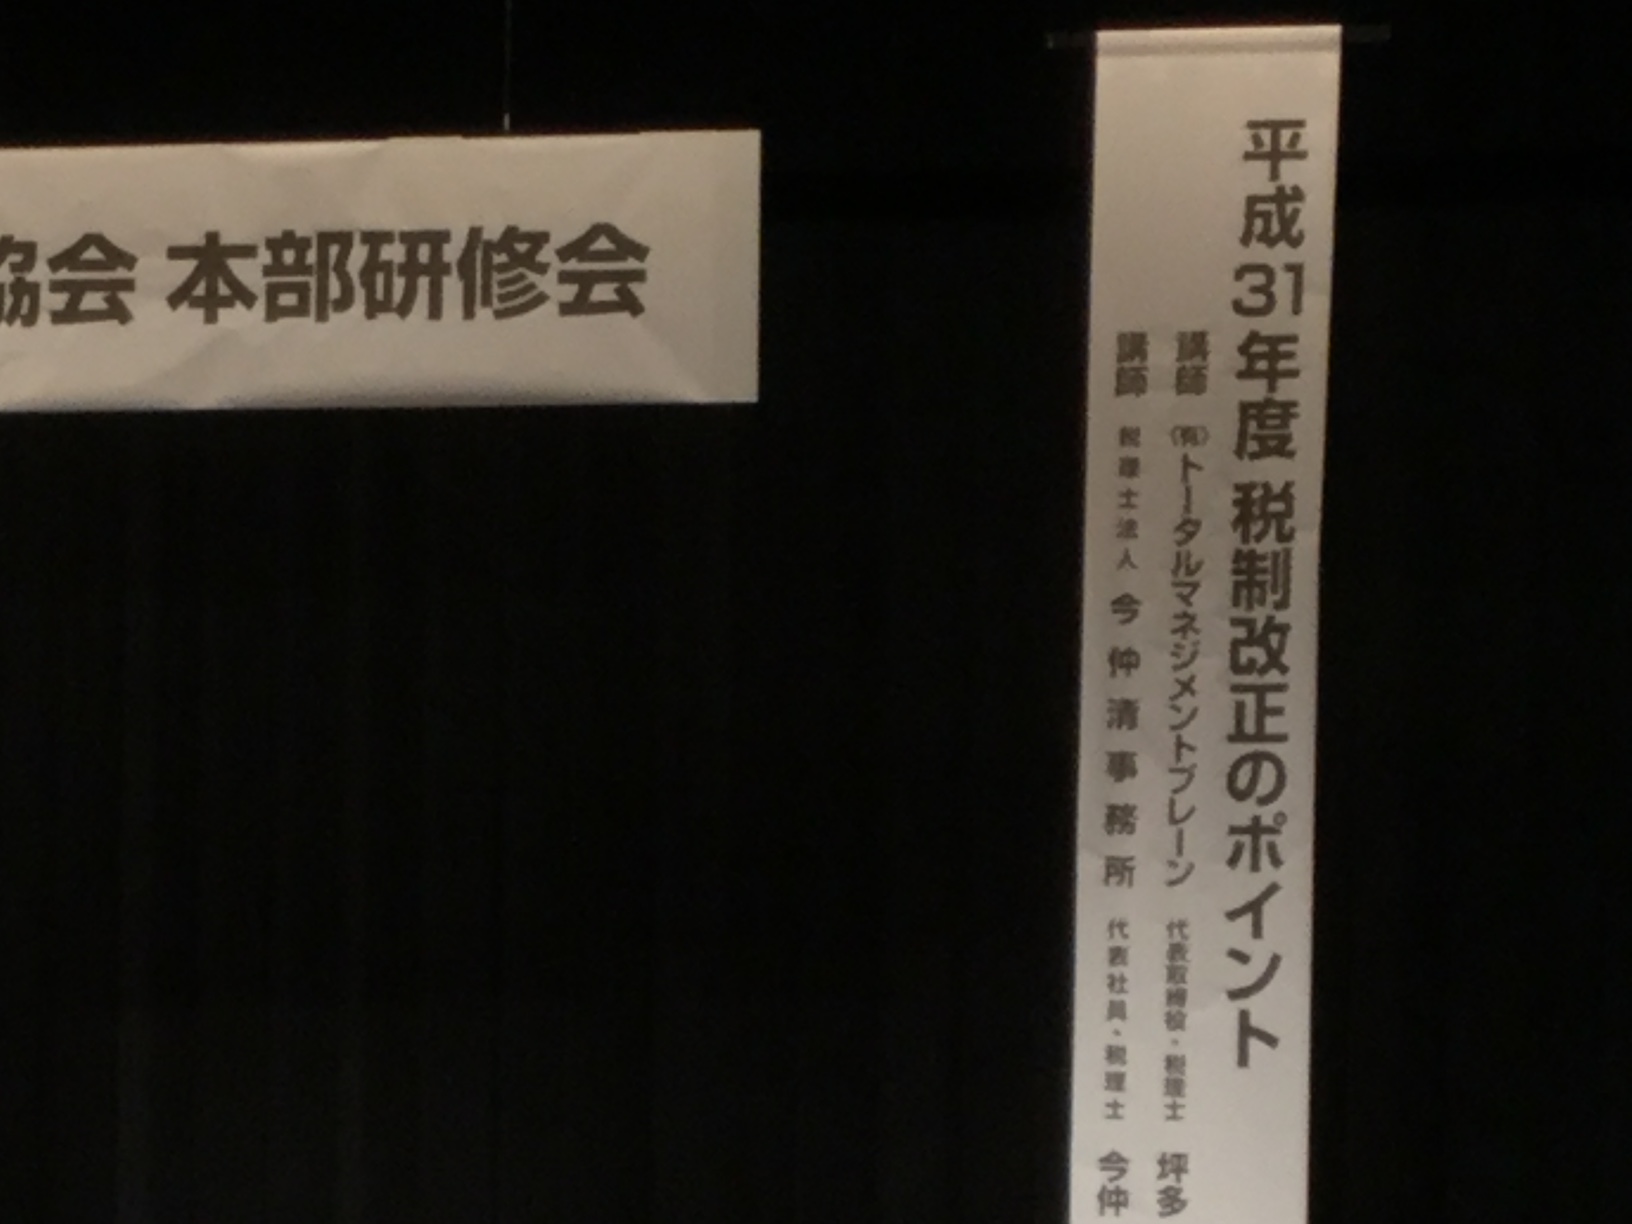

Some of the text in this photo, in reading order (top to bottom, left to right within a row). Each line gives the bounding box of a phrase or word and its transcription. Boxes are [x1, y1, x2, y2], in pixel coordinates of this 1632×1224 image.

[164, 221, 652, 326] 本部研修会
[1223, 118, 1310, 1070] 平成31年度 税制改正のポイント
[1101, 591, 1143, 889] 今仲清事務所
[1096, 1149, 1130, 1217] 今仲
[1156, 1151, 1190, 1219] 坪多
